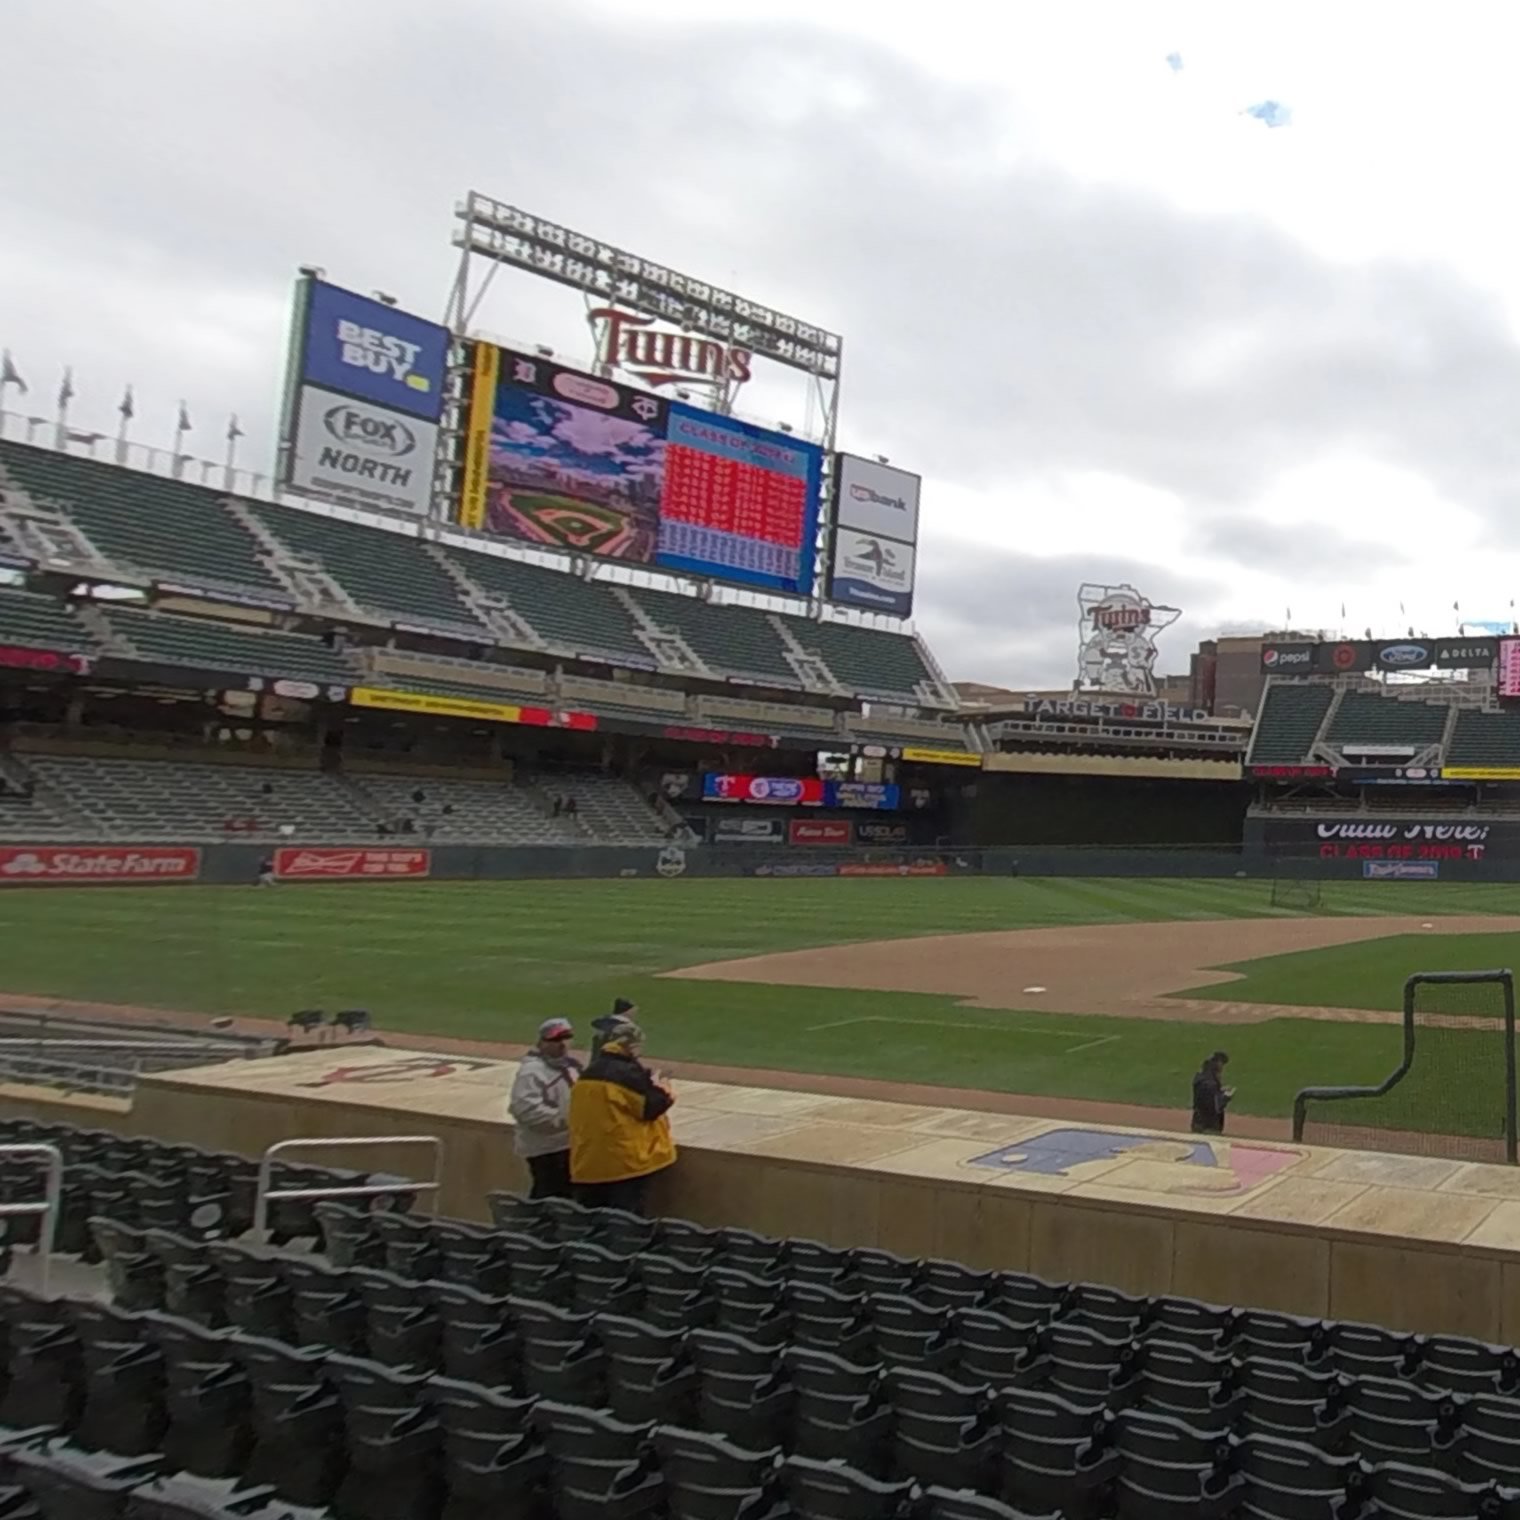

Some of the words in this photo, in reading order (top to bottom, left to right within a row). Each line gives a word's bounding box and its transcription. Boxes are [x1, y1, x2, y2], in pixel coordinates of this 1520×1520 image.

[337, 319, 421, 365] BEST
[588, 307, 752, 384] Twins
[341, 342, 412, 382] BUY
[343, 411, 397, 440] FOX
[318, 446, 412, 487] NORTH
[1086, 604, 1151, 632] Twins
[1280, 650, 1310, 665] pepsi
[1452, 648, 1489, 658] DELTA
[1024, 700, 1119, 717] TARGET
[1143, 706, 1208, 721] FIELD
[49, 854, 123, 873] State
[122, 853, 187, 872] Farm
